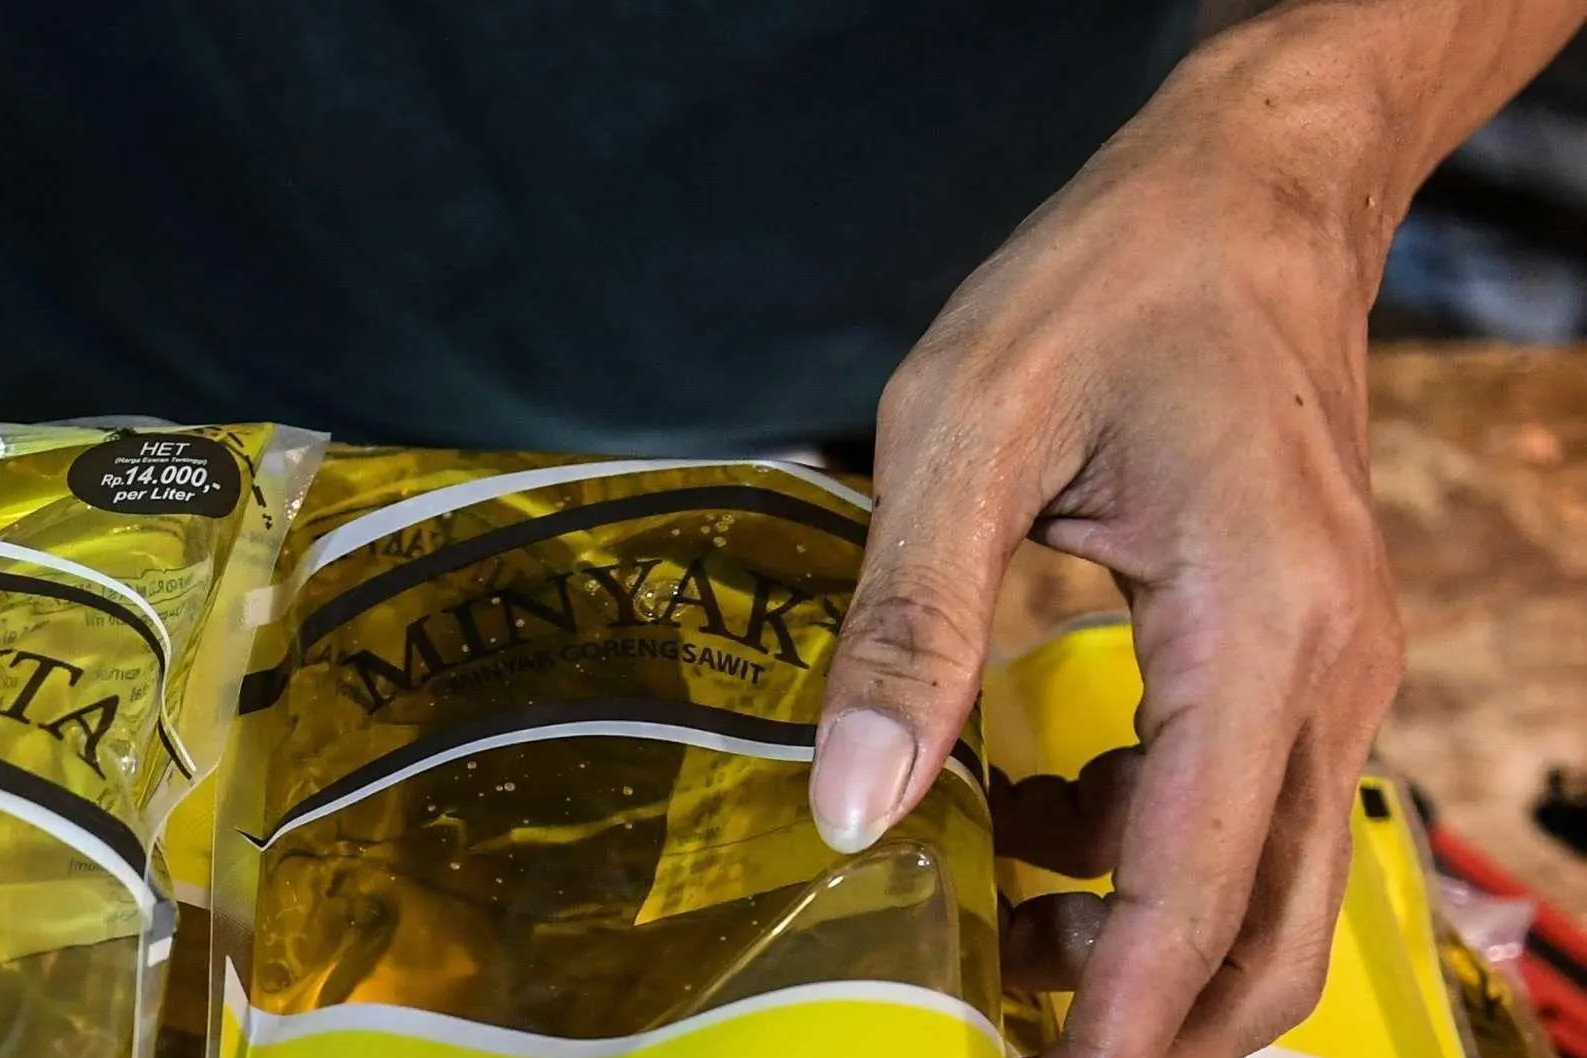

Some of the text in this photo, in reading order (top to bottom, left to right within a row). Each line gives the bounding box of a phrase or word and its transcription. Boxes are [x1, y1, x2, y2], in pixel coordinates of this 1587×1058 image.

[140, 442, 191, 456] HET
[113, 487, 195, 503] per Liter
[681, 643, 767, 685] SAWIT
